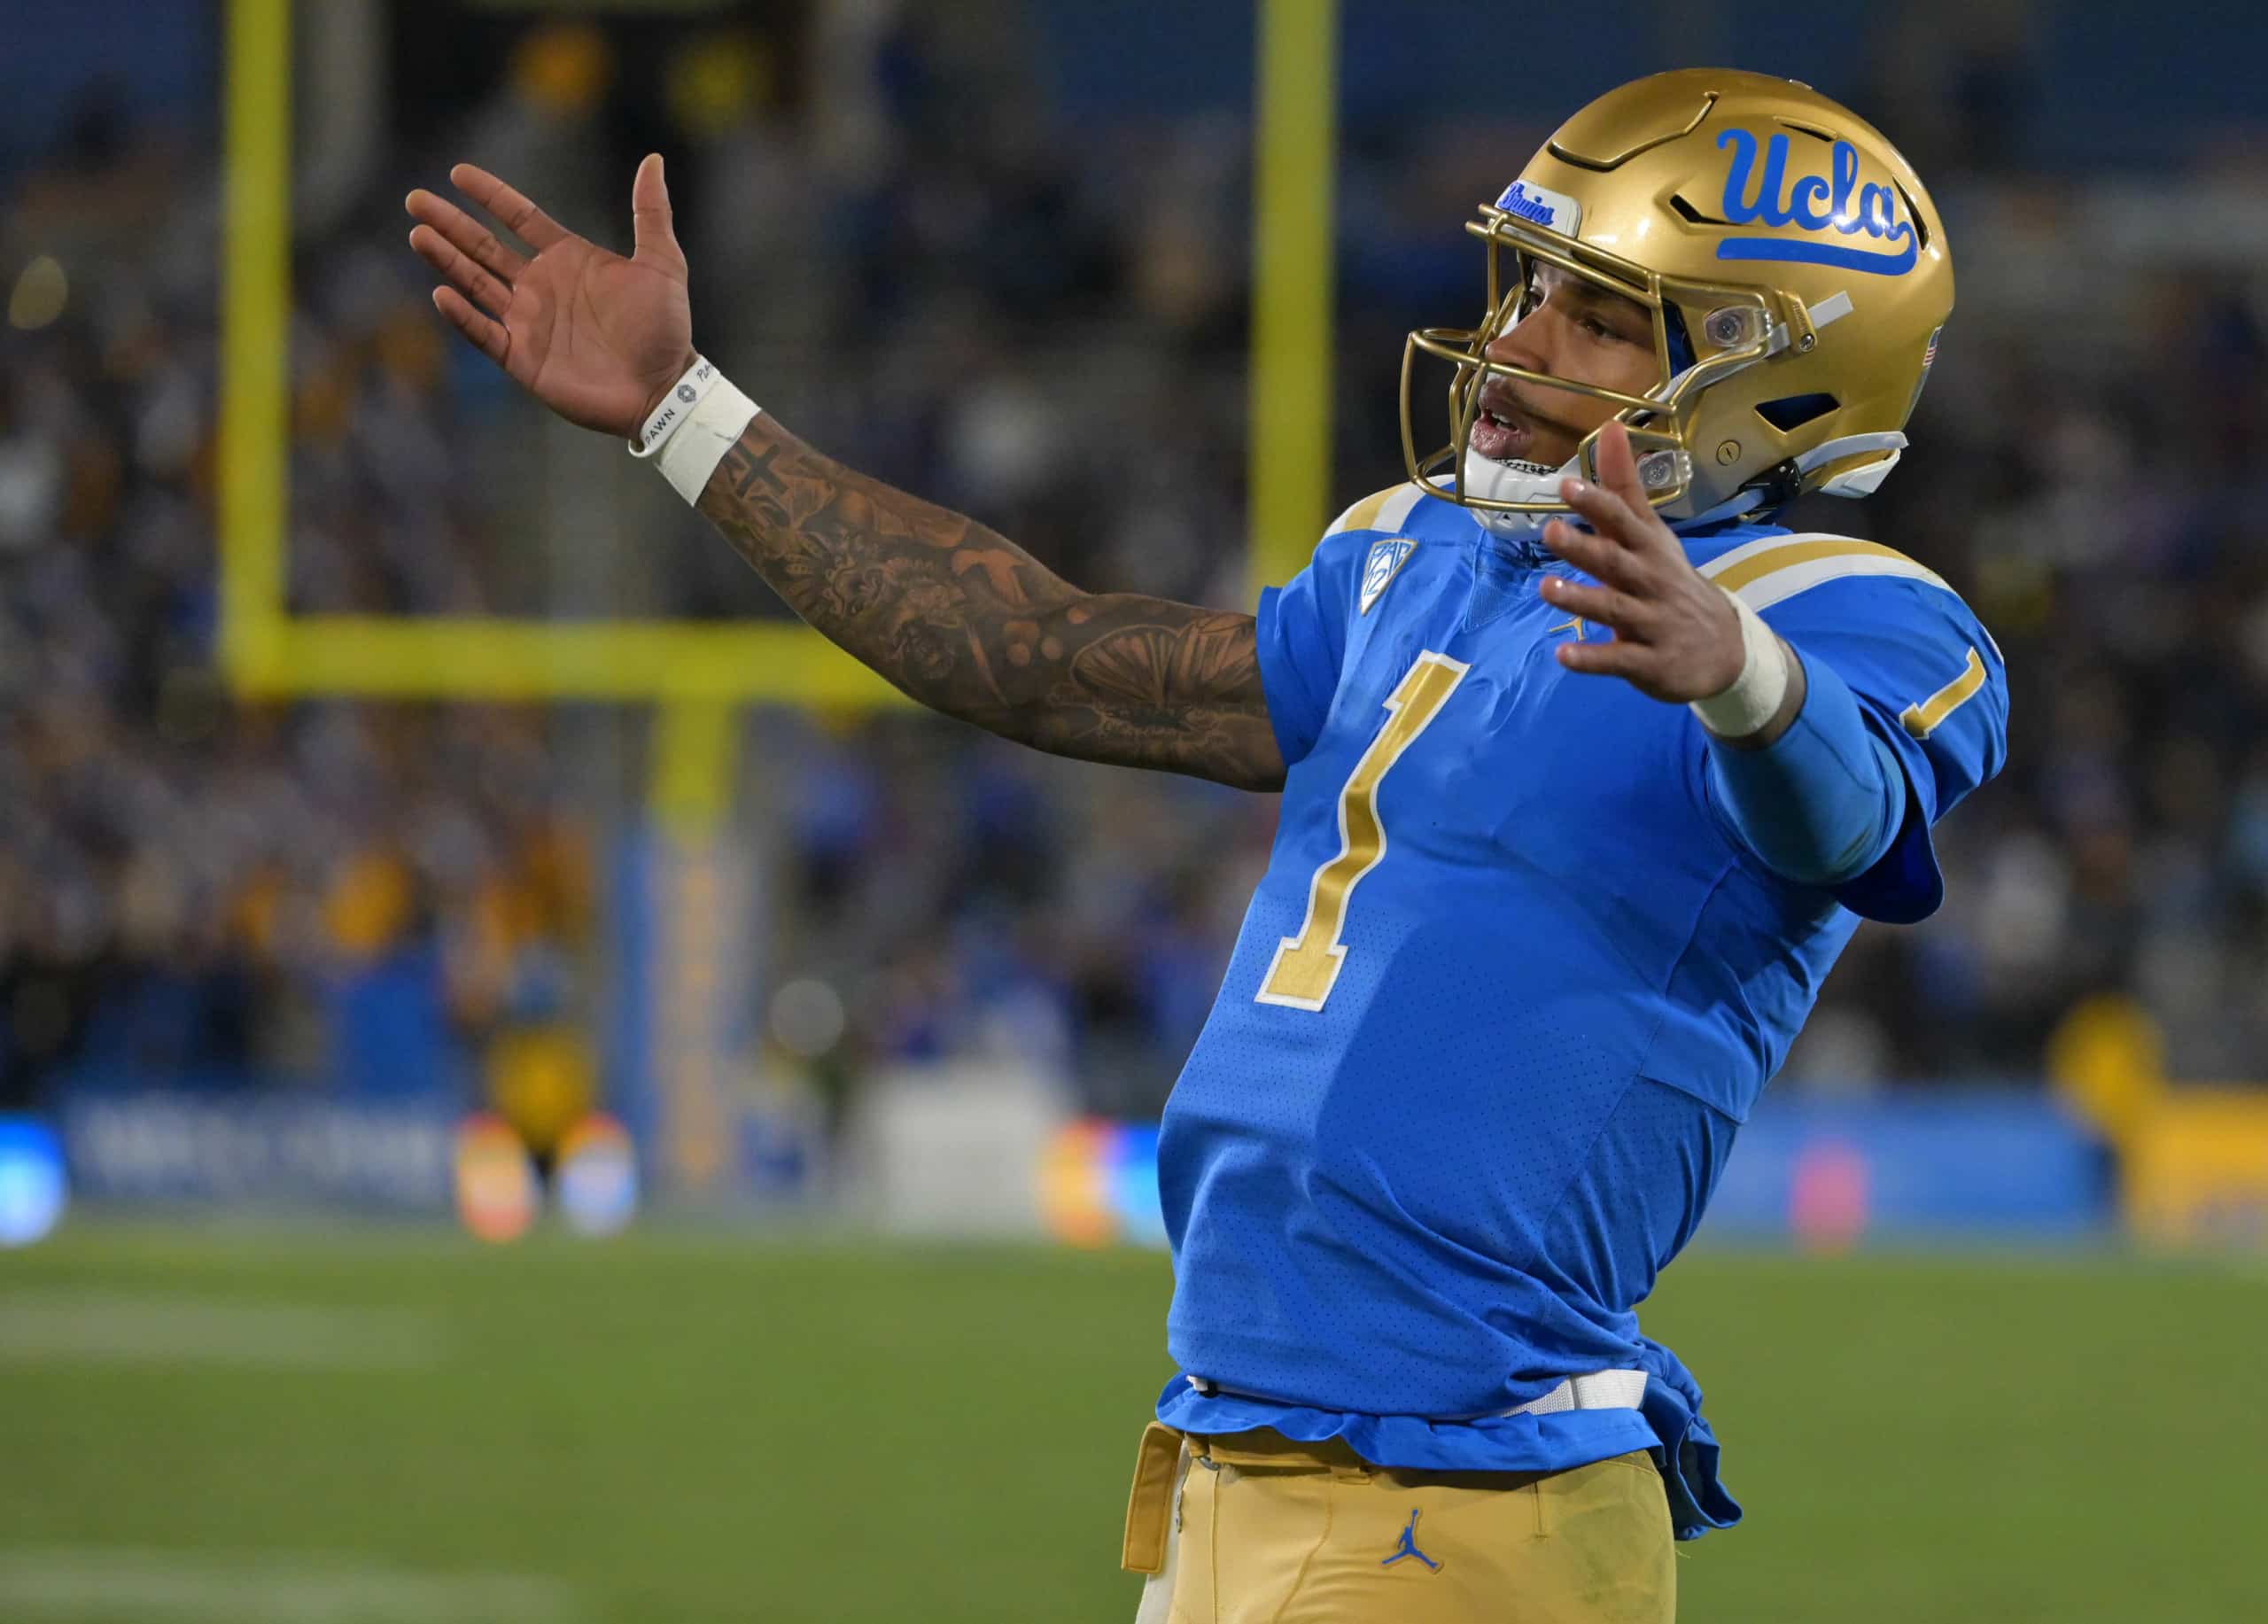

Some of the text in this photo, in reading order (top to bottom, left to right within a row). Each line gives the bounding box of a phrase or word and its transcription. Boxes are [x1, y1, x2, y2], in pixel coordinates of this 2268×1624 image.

[1497, 182, 1555, 226] Bruins
[645, 408, 675, 446] PAWN
[1899, 646, 1986, 741] 1
[1254, 649, 1472, 1013] 1
